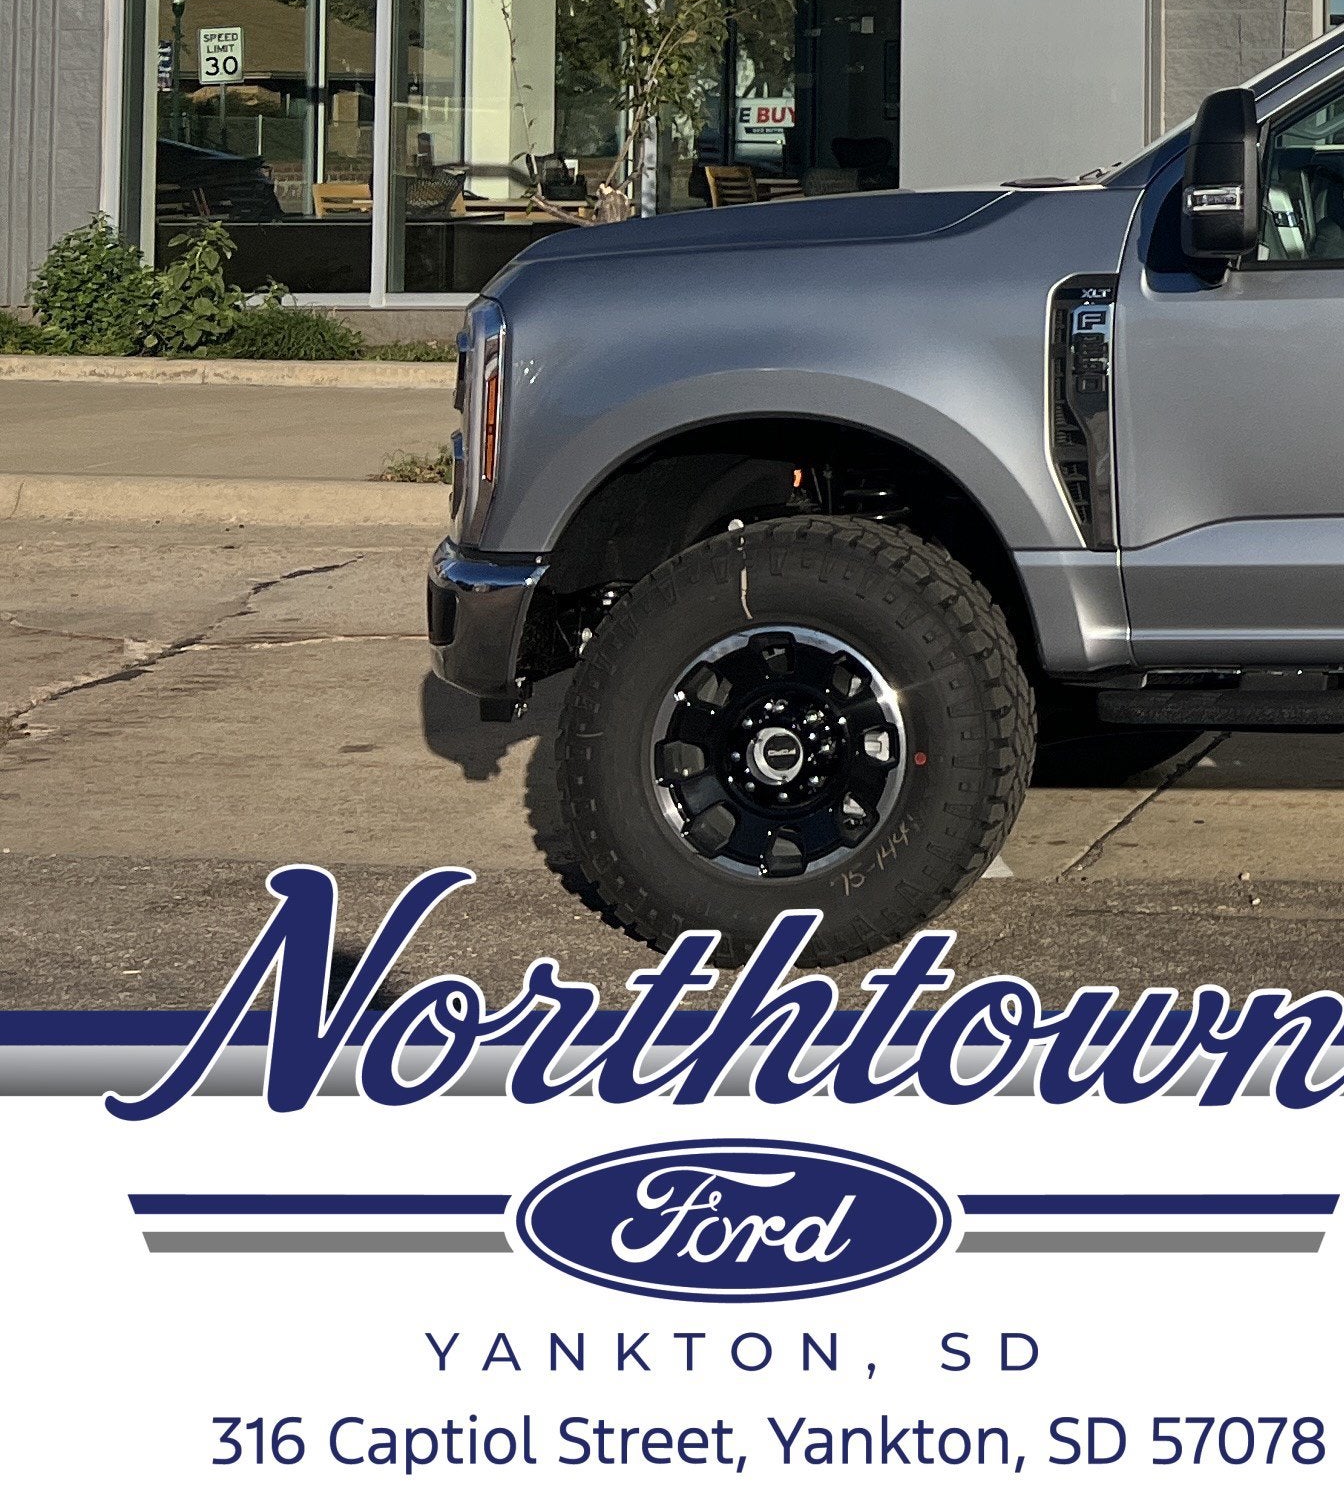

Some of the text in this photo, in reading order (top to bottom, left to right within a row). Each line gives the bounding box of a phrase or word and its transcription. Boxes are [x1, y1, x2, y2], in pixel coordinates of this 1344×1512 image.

[203, 32, 239, 43] SPEED
[206, 43, 235, 54] LIMIT
[205, 55, 239, 76] 30
[756, 107, 796, 124] BUY
[1081, 288, 1111, 299] XLT
